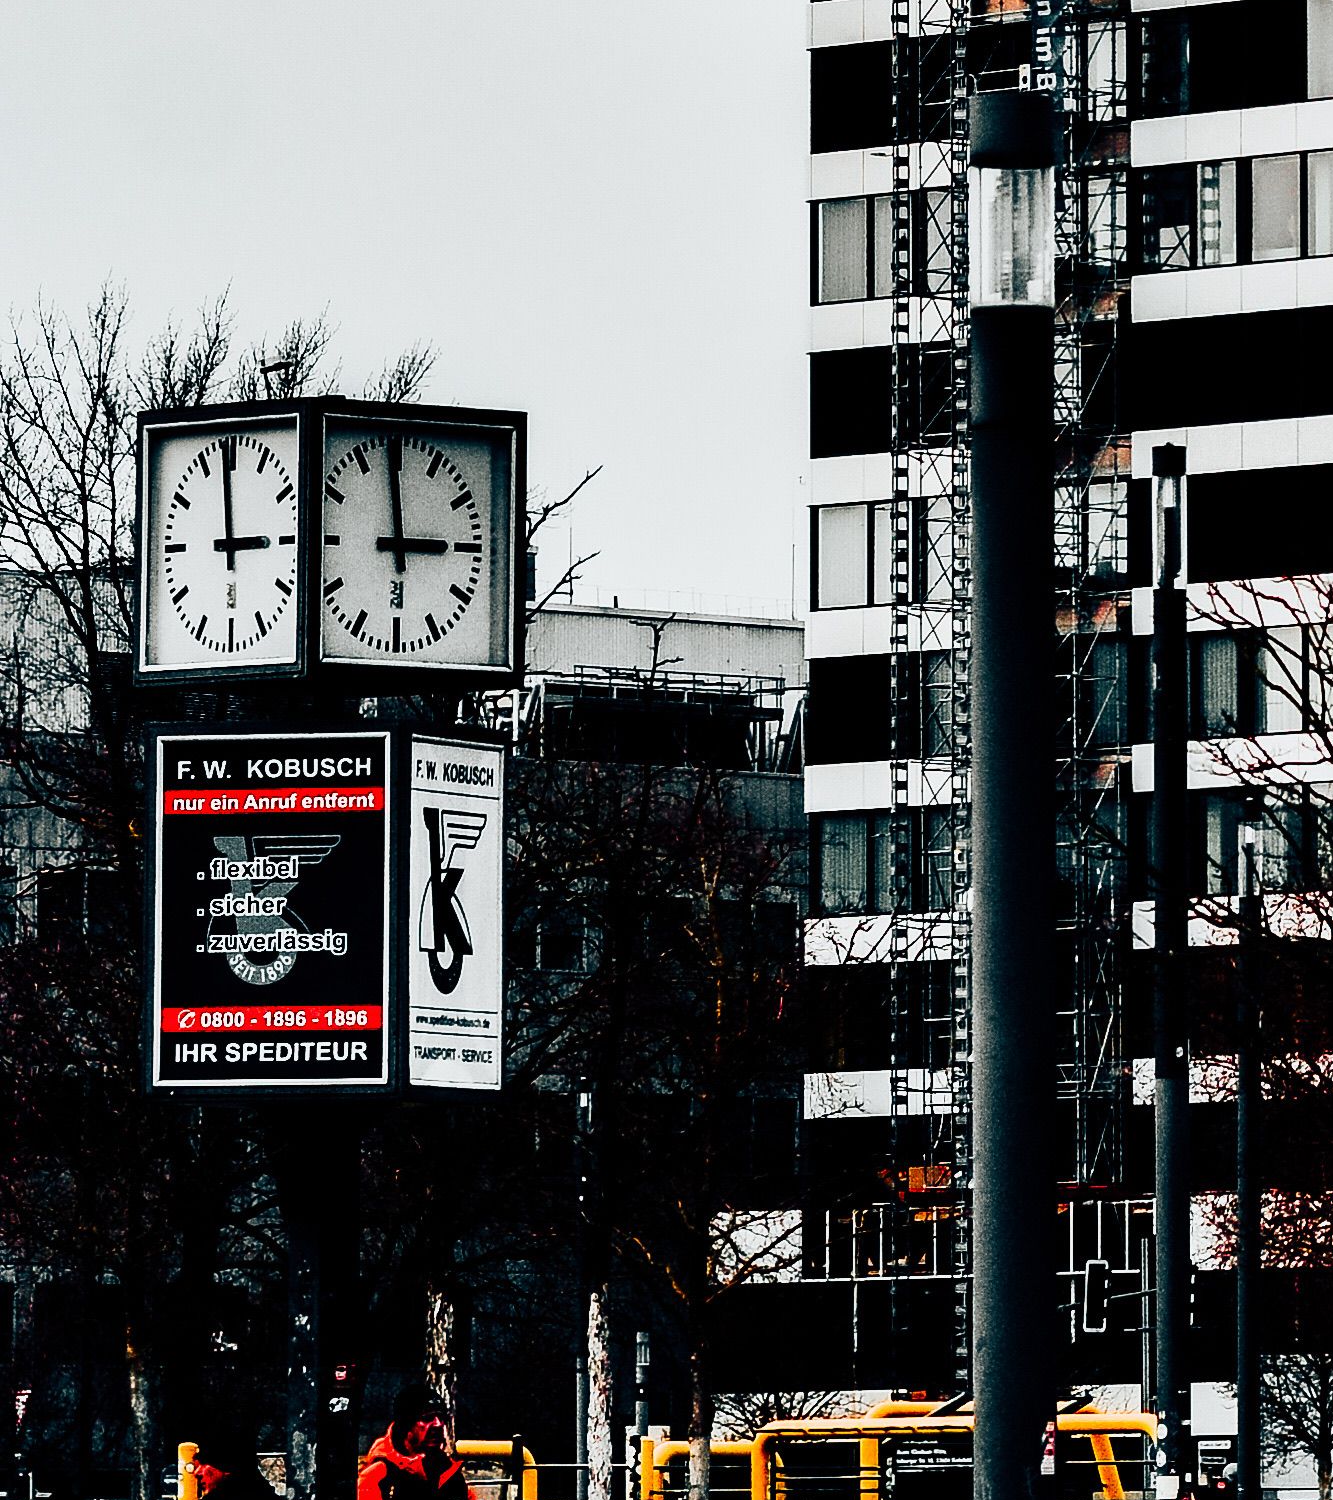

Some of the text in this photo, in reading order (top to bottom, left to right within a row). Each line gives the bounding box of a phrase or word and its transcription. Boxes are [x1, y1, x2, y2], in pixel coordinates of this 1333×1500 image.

[177, 757, 371, 780] F. W. KOBUSCH
[426, 760, 438, 780] W.
[443, 763, 494, 788] KOBUSCH
[173, 792, 375, 811] nur ein Anruf entfernt
[210, 856, 299, 880] flexibel
[209, 892, 288, 917] sicher
[207, 928, 348, 956] zuverlässig
[229, 953, 293, 983] SEIT 1896
[201, 1011, 245, 1028] 0800
[263, 1010, 307, 1028] 1896
[324, 1009, 368, 1027] 1896
[175, 1041, 368, 1063] IHR SPEDITEUR
[414, 1046, 493, 1064] TRANSPORT SERVICE
